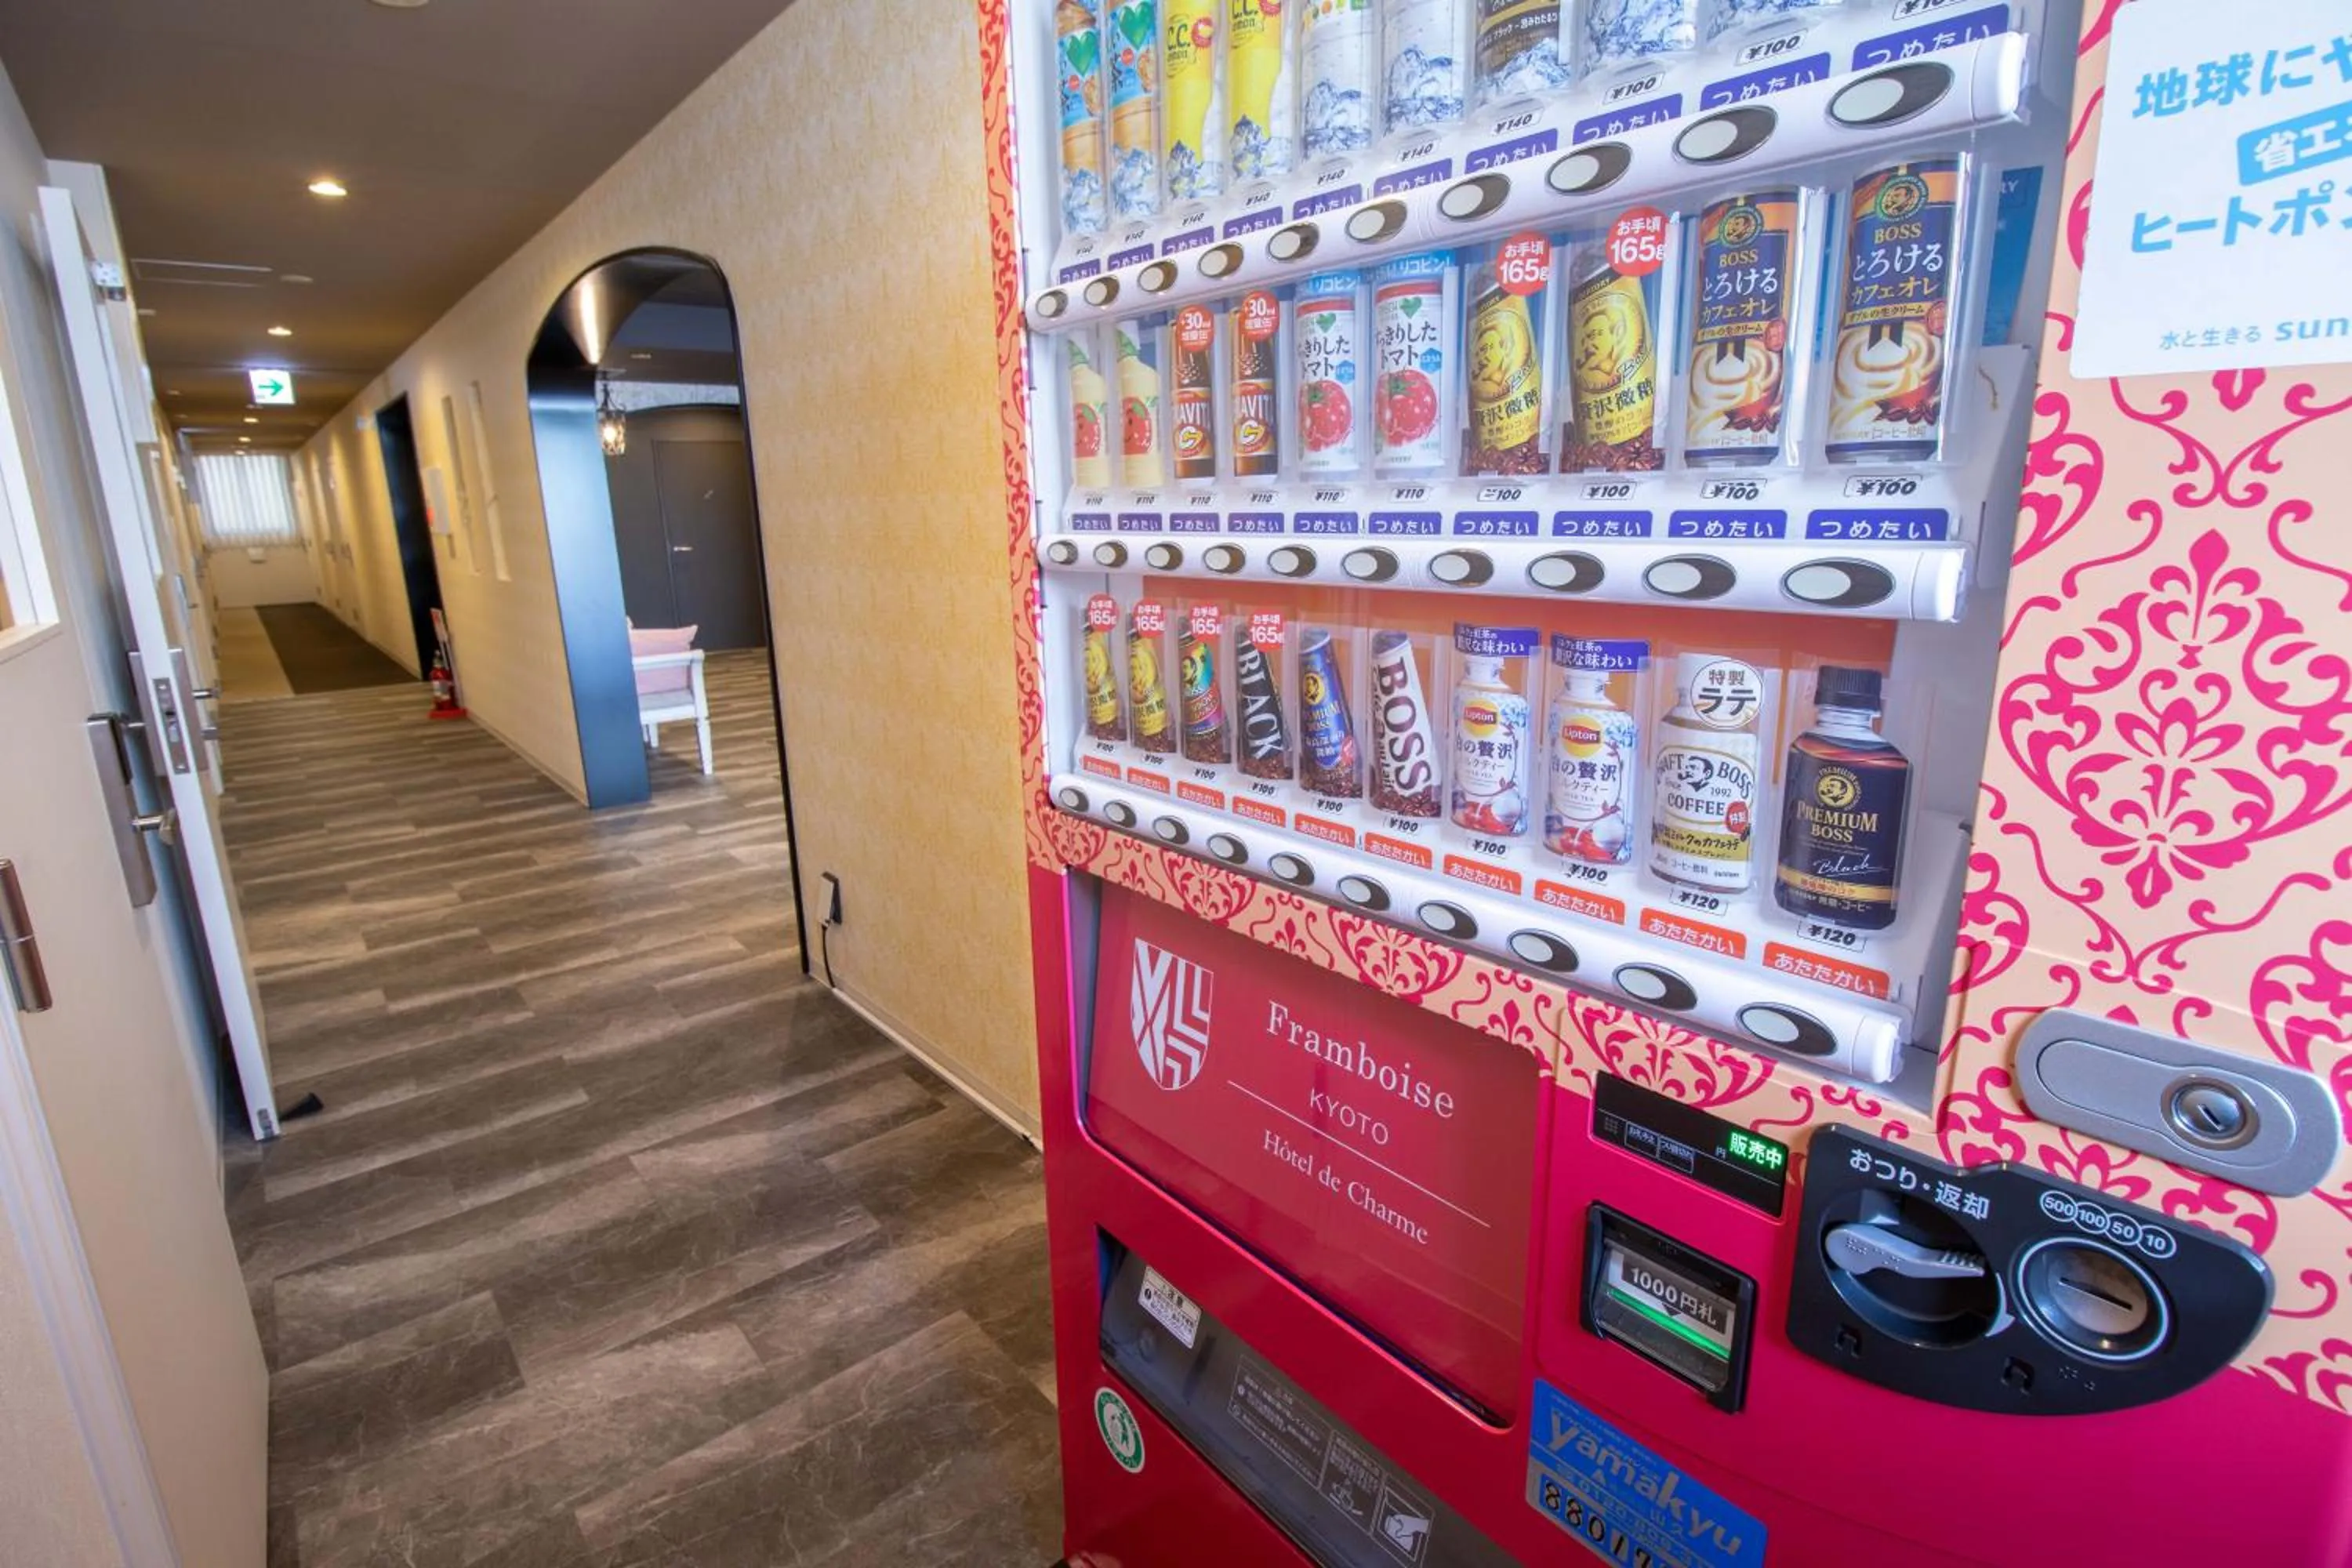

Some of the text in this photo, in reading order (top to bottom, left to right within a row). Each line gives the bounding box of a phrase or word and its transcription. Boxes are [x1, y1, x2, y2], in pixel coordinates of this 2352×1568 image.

[1748, 35, 1800, 60] ¥100
[1611, 78, 1657, 99] ¥100
[1494, 113, 1533, 134] ¥140
[1402, 143, 1433, 161] ¥140
[2254, 118, 2352, 173] 省エ
[1617, 216, 1661, 235] お手頃
[2131, 180, 2352, 253] ヒートポ
[1874, 223, 1922, 244] BOSS
[1504, 240, 1544, 259] お手頃
[1719, 249, 1759, 267] BOSS
[1852, 242, 1944, 282] とろける
[1702, 267, 1778, 301] とろける
[1851, 276, 1940, 304] カフェオレ
[1701, 297, 1777, 323] カフェオレ
[2159, 325, 2262, 350] 水と生きる
[1315, 489, 1340, 502] ¥110
[1396, 488, 1425, 499] ¥110
[1587, 485, 1630, 499] ¥100
[1711, 483, 1759, 501] ¥100
[1857, 477, 1918, 496] ¥100
[1174, 519, 1216, 532] つめたい
[1232, 517, 1279, 532] つめたい
[1299, 519, 1353, 532] つめたい
[1374, 520, 1435, 533] つめたい
[1461, 520, 1530, 535] つめたい
[1562, 521, 1642, 536] つめたい
[1679, 521, 1774, 538] つめたい
[1820, 521, 1933, 539] つめたい
[1708, 669, 1745, 686] 特製
[1239, 648, 1287, 760] BLACK
[1698, 686, 1757, 717] ラテ
[1378, 655, 1432, 790] BOSS
[1465, 709, 1494, 722] Lipton
[1563, 726, 1598, 742] Lipton
[1716, 760, 1752, 800] BOSS
[1710, 786, 1732, 798] 1992
[1317, 798, 1344, 812] ¥100
[1667, 793, 1726, 817] COFFEE
[1389, 818, 1419, 833] ¥100
[1796, 800, 1879, 833] PREMIUM
[1300, 819, 1352, 844] あたたかい
[1810, 822, 1853, 844] BOSS
[1370, 840, 1427, 866] あたたかい
[1473, 839, 1507, 855] ¥100
[1450, 862, 1514, 892] あたたかい
[1570, 863, 1609, 882] ¥100
[1542, 888, 1617, 920] あたたかい
[1680, 891, 1720, 911] ¥120
[1649, 917, 1736, 954] あたたかい
[1809, 924, 1857, 946] ¥120
[1774, 952, 1876, 995] あたたかい
[1265, 999, 1457, 1120] Framboise
[1309, 1087, 1390, 1145] KYOTO
[1730, 1131, 1784, 1170] 販売中
[1263, 1129, 1430, 1245] Hôtel de Charme
[1849, 1148, 1991, 1221] おつり・返却
[2044, 1196, 2165, 1251] 500 100 50 10
[1630, 1266, 1719, 1325] 1000円札
